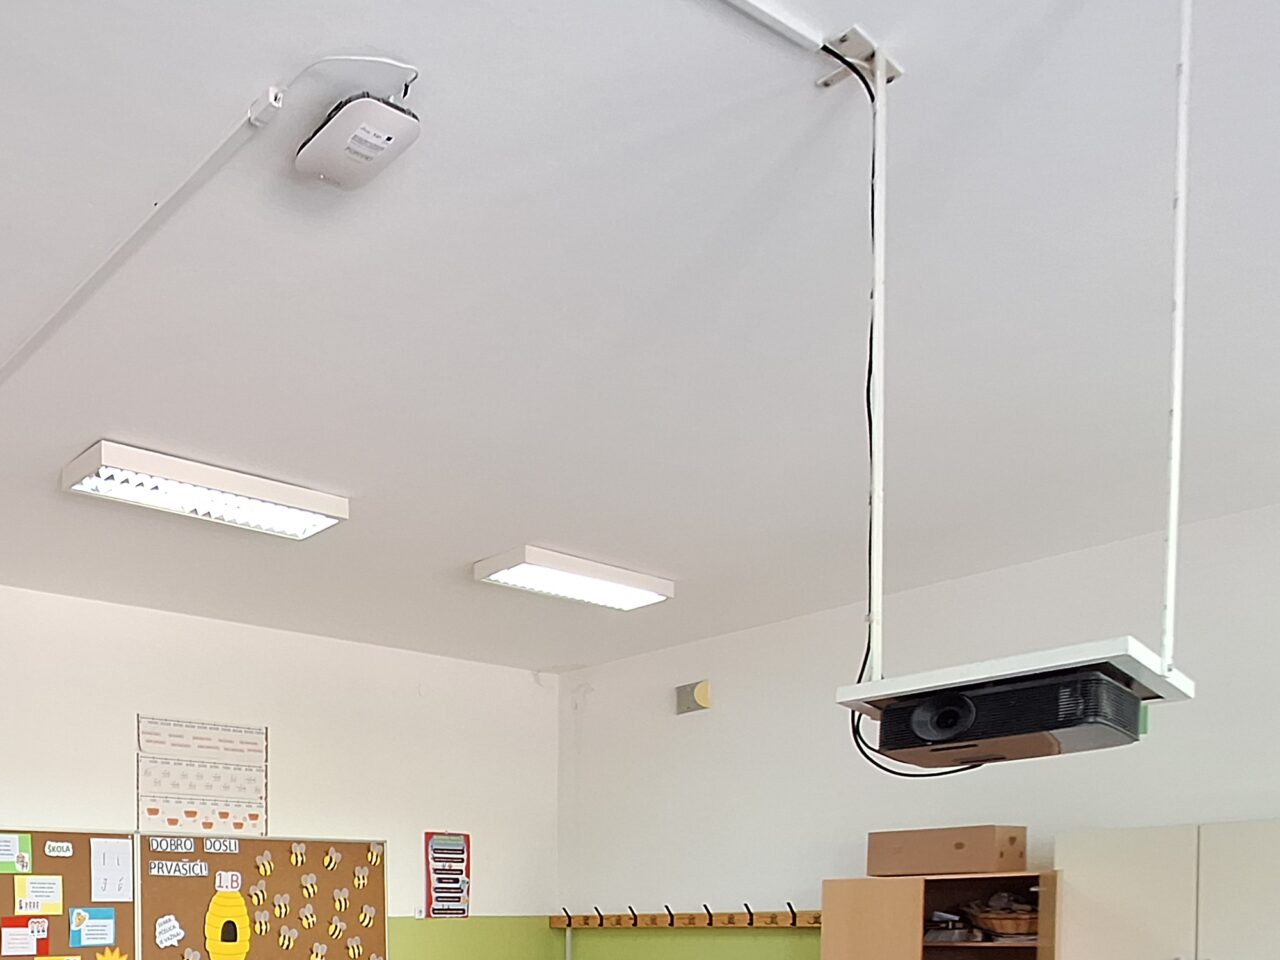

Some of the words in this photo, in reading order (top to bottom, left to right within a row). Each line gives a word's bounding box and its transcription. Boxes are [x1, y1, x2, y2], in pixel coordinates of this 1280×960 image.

[47, 844, 71, 854] ŠKOLA
[151, 838, 193, 851] DOBRO
[216, 873, 240, 889] 1.B
